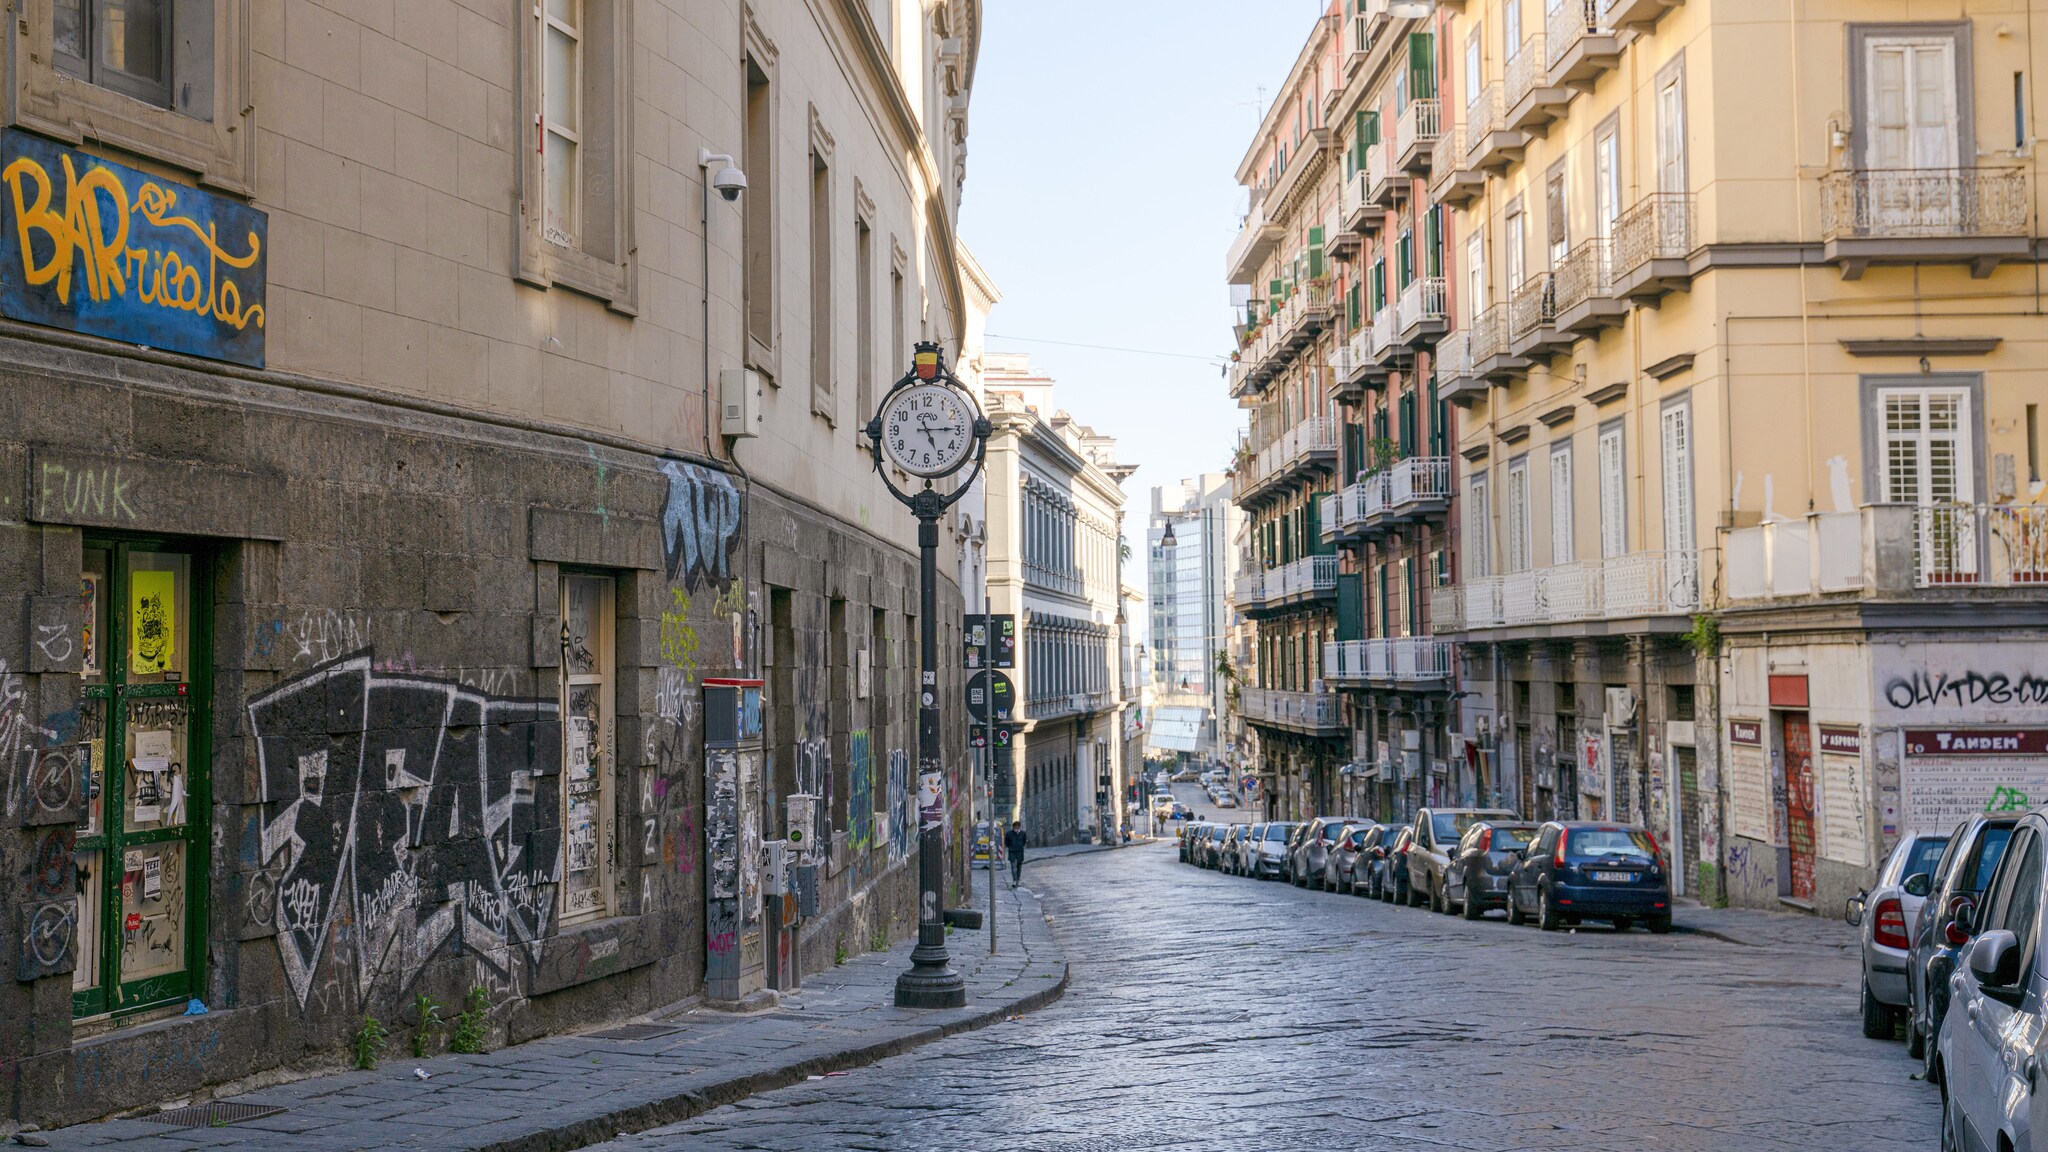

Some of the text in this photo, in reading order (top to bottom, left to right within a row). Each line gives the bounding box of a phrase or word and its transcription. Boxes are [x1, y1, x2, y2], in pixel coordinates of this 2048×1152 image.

[910, 400, 917, 410] 11
[922, 396, 932, 407] 12
[898, 411, 908, 422] 10
[949, 410, 956, 420] 2
[893, 425, 899, 436] 9
[954, 425, 960, 436] 3
[899, 440, 904, 450] 8
[948, 440, 955, 450] 4
[910, 450, 916, 460] 7
[924, 453, 930, 464] 6
[938, 450, 944, 460] 5
[40, 463, 137, 519] FUNK
[1830, 734, 1860, 748] ASPORTO
[1936, 732, 2019, 750] TANDEM
[706, 931, 736, 953] WOF
